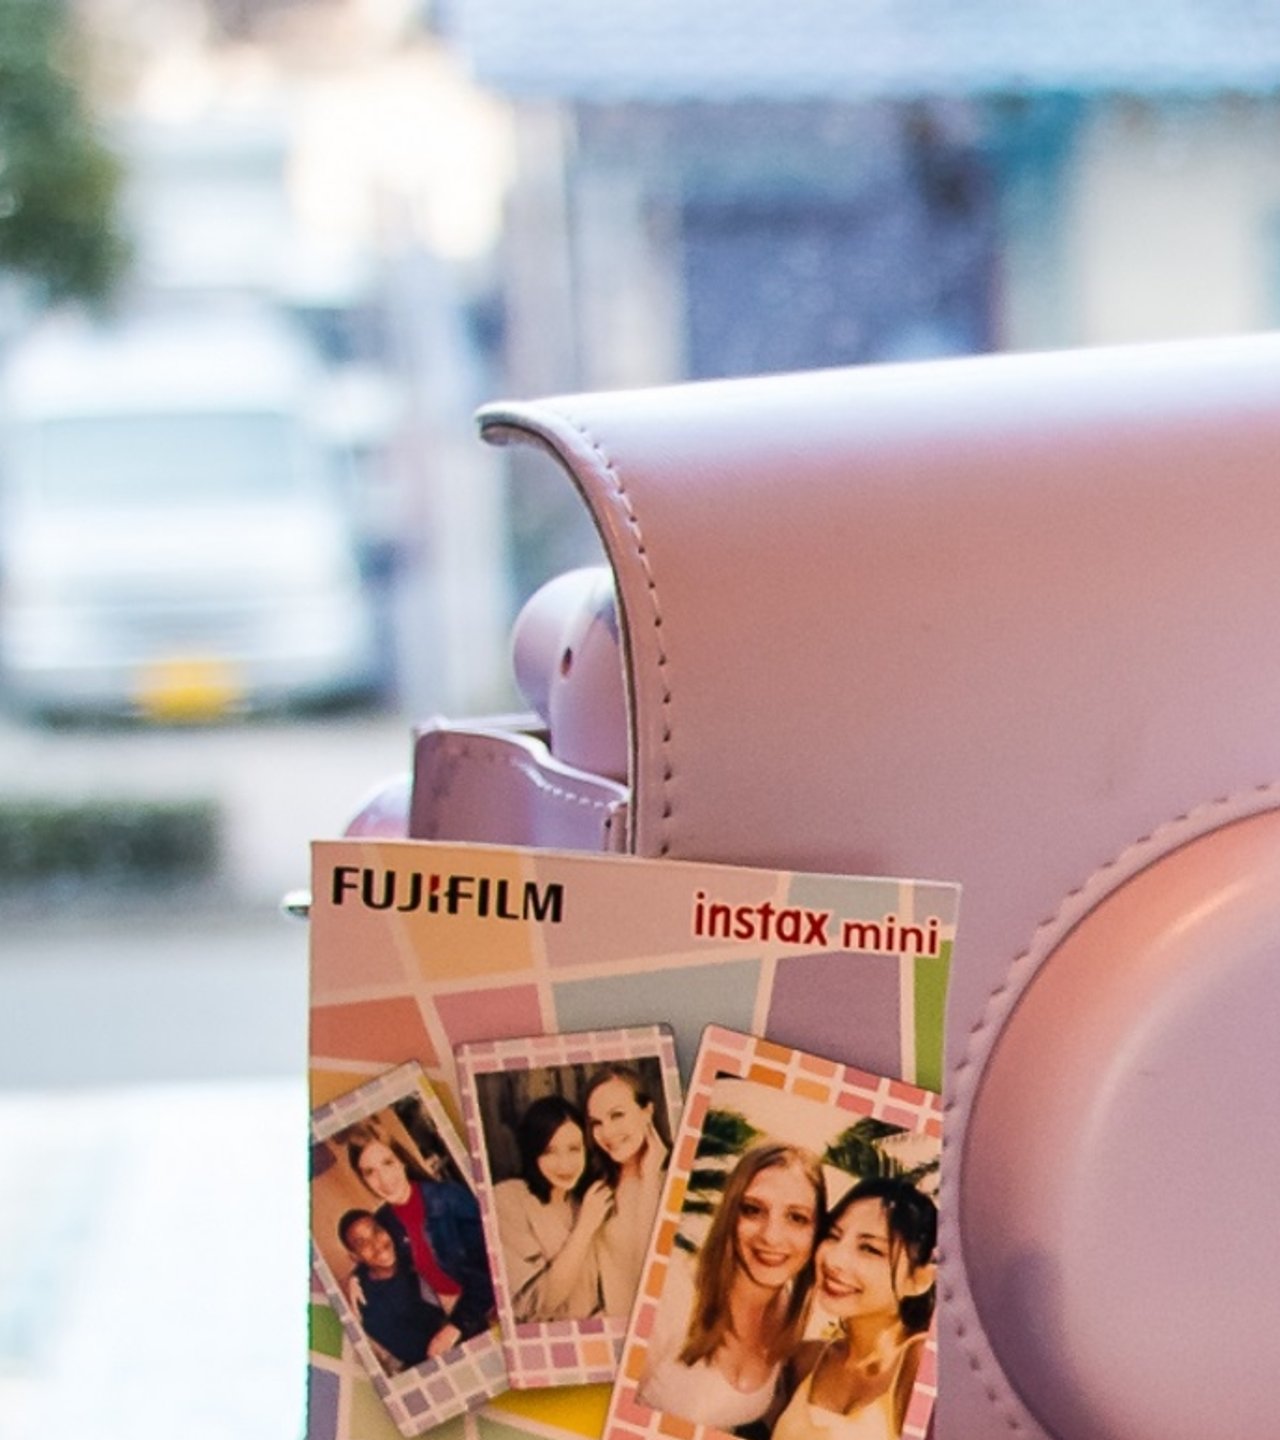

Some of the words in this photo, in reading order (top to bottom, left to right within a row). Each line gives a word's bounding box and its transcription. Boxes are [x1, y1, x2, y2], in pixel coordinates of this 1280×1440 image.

[332, 866, 564, 923] FUJIFILM
[693, 892, 829, 947] instax
[843, 917, 940, 955] mini
